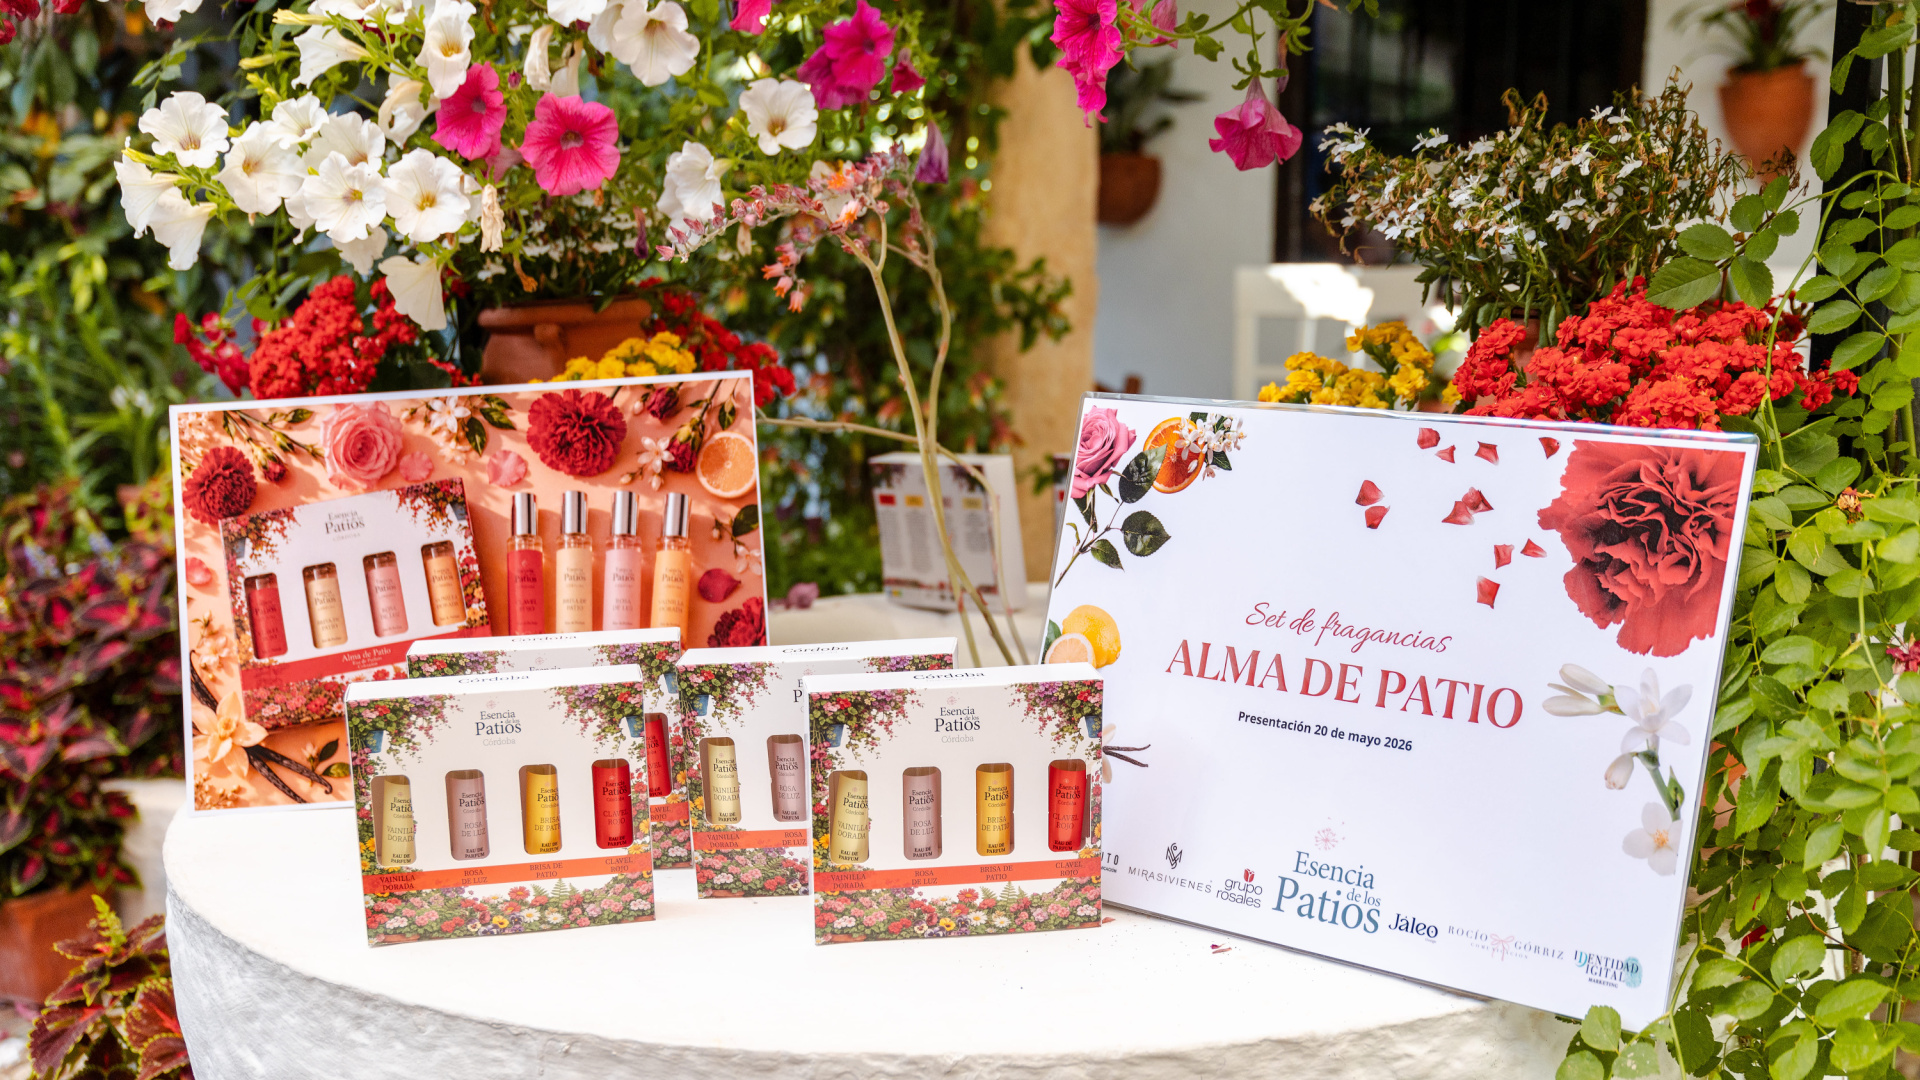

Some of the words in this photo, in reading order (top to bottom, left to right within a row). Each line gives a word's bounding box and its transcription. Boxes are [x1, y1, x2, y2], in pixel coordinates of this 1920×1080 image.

[325, 519, 365, 534] Patios
[1246, 602, 1285, 629] Set
[1290, 609, 1315, 635] de
[1314, 612, 1452, 653] fragancias
[342, 654, 361, 662] Alma
[373, 647, 391, 656] Patio
[459, 675, 529, 683] Córdoba
[1166, 639, 1288, 692] ALMA
[1300, 658, 1364, 704] DE
[1375, 670, 1523, 729] PATIO
[480, 710, 515, 720] Esencia
[940, 706, 975, 716] Esencia
[475, 721, 521, 736] Patios
[935, 718, 980, 732] Patios
[1238, 711, 1311, 734] Presentación
[1314, 725, 1328, 737] 20
[1331, 727, 1345, 740] de
[1348, 732, 1381, 748] mayo
[1384, 737, 1412, 751] 2026
[483, 737, 515, 746] Córdoba
[941, 734, 974, 743] Córdoba
[713, 764, 737, 772] Patios
[775, 762, 798, 770] Patios
[602, 787, 627, 795] Patios
[985, 791, 1009, 801] Patios
[1056, 789, 1080, 799] Patios
[459, 798, 484, 807] Patios
[537, 793, 559, 802] Patio
[909, 795, 934, 805] Patios
[390, 803, 412, 812] Patio
[843, 798, 868, 809] Patios
[603, 809, 628, 817] CLAVEL
[387, 826, 414, 834] VAINILL
[473, 828, 486, 836] LUZ
[837, 830, 865, 839] DORADA
[922, 827, 934, 835] LUZ
[605, 857, 633, 865] CLAVEL
[1293, 851, 1374, 889] Esencia
[380, 875, 415, 883] VAINILLA
[831, 873, 866, 881] VAINILLA
[1128, 866, 1212, 893] MIRASIVIENES
[383, 883, 414, 891] DORADA
[1225, 879, 1262, 896] grupo
[1216, 889, 1261, 908] rosales
[1347, 888, 1361, 902] de
[1364, 891, 1381, 907] los
[1272, 876, 1380, 933] Patios
[1448, 926, 1488, 941] ROCÍO
[1515, 941, 1563, 960] GÓRRIZ
[1574, 950, 1638, 973] IDENTIDAD
[1589, 978, 1618, 988] MARKETING
